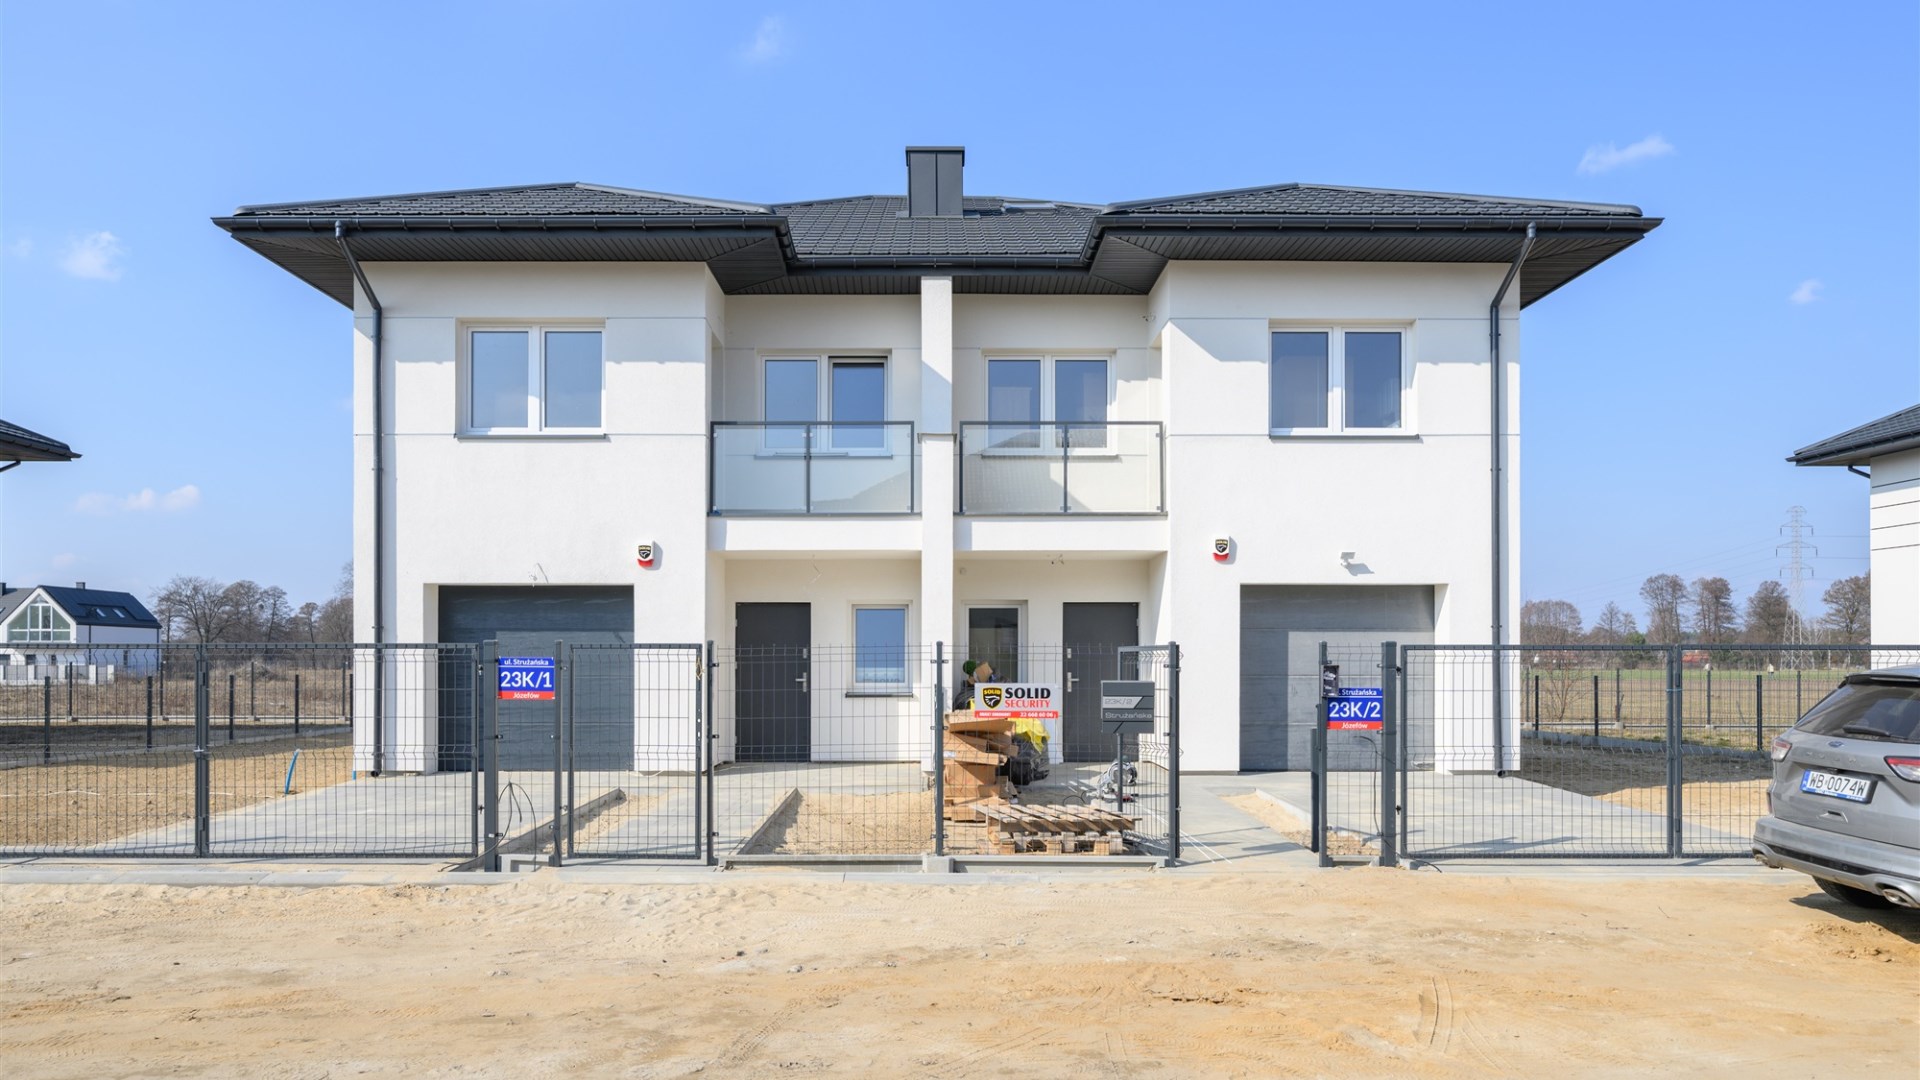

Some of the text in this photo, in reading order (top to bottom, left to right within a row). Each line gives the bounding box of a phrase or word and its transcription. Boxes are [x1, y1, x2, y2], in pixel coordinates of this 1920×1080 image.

[513, 658, 549, 666] Strużańska
[500, 671, 553, 689] 23K/1
[1005, 687, 1051, 699] SOLID
[1341, 688, 1377, 696] Strużańska
[1005, 700, 1051, 708] SECURITY
[1328, 701, 1381, 719] 23K/2
[1809, 773, 1825, 789] WB
[1826, 776, 1867, 797] 0074W
